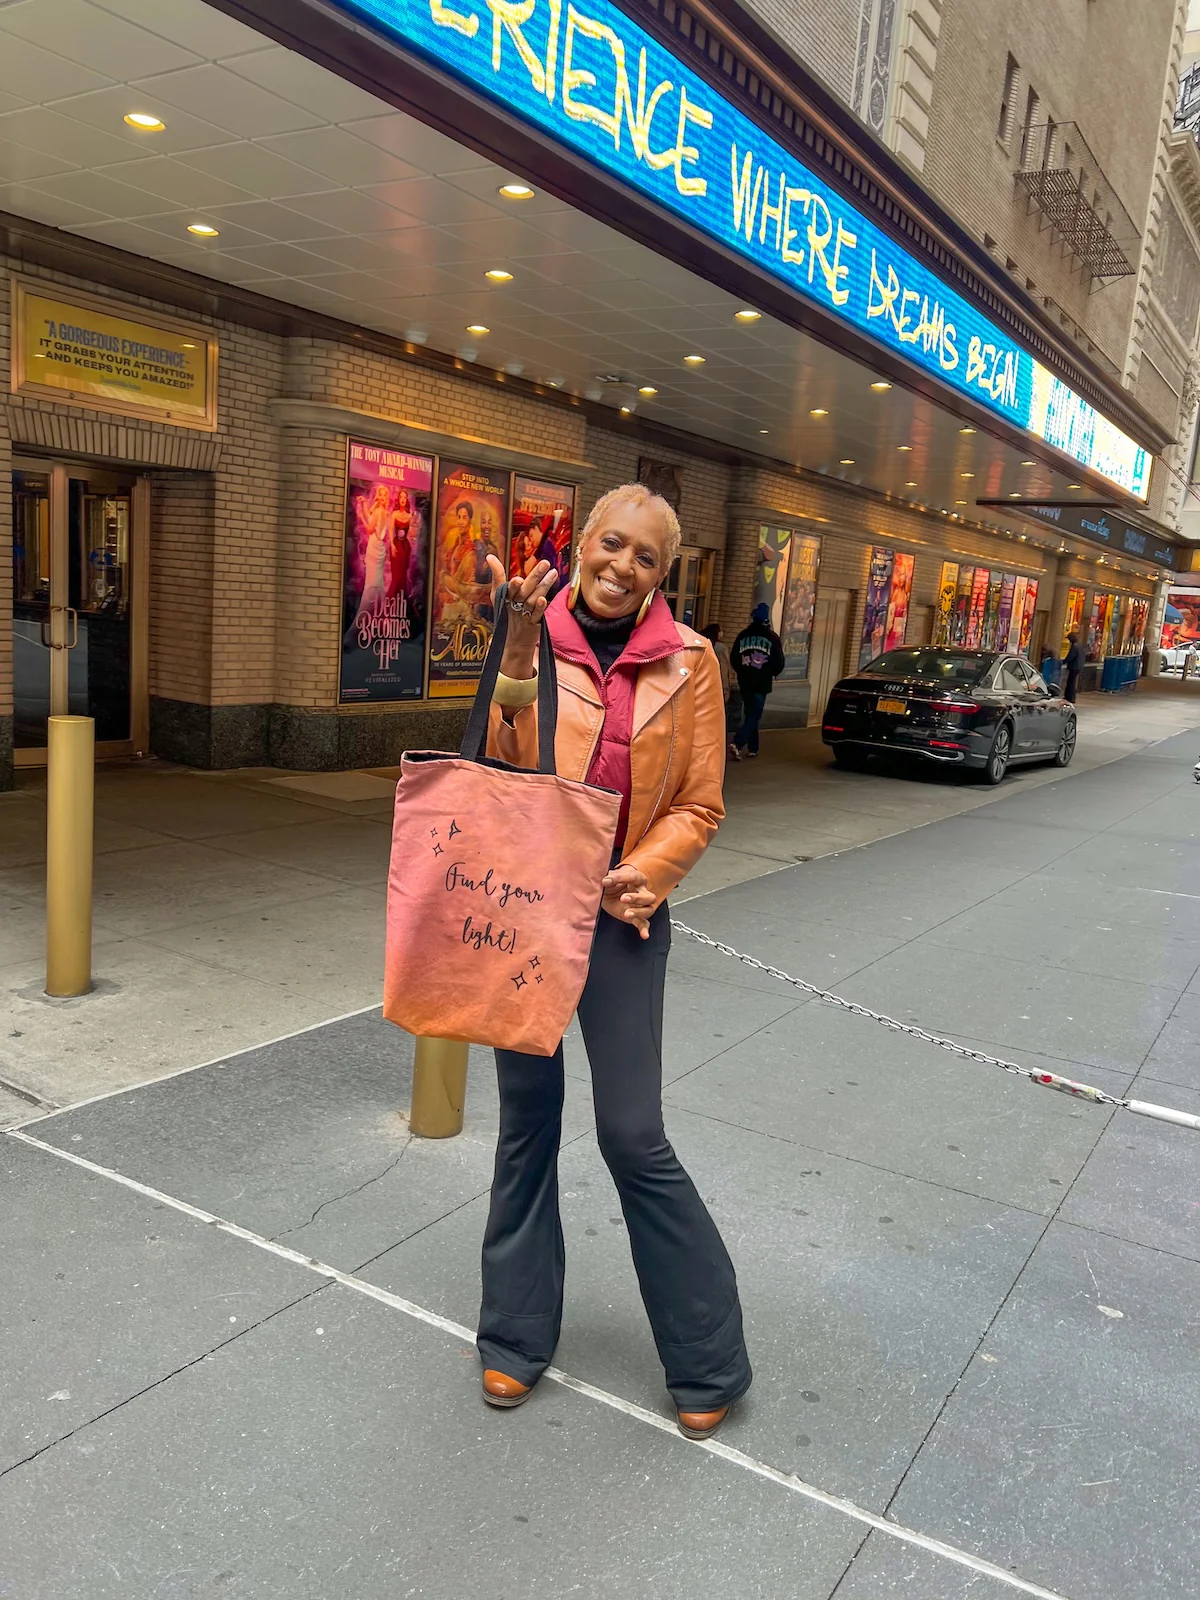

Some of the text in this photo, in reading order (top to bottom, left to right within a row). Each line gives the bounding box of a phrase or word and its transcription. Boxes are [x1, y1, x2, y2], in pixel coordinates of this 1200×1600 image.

[731, 142, 857, 305] WHERE
[866, 248, 959, 370] DREAMS
[966, 335, 1020, 409] BEGIN.
[59, 323, 120, 353] GORGEOUS
[39, 338, 194, 381] IT GRABS YOUR ATTENTION
[46, 351, 71, 363] AND
[74, 357, 113, 373] KEEPS
[115, 366, 139, 379] YOU
[351, 445, 363, 460] THE
[364, 448, 380, 463] TONY
[378, 464, 405, 481] MUSICAL
[443, 477, 449, 485] A
[449, 479, 470, 489] WHOLE
[470, 483, 484, 492] NEW
[461, 473, 490, 485] STEP INTO
[370, 589, 407, 618] Death
[355, 610, 411, 649] Becomes
[373, 639, 401, 669] Her
[739, 635, 773, 656] MARKET
[445, 861, 545, 908] Find your
[462, 916, 517, 955] light!
